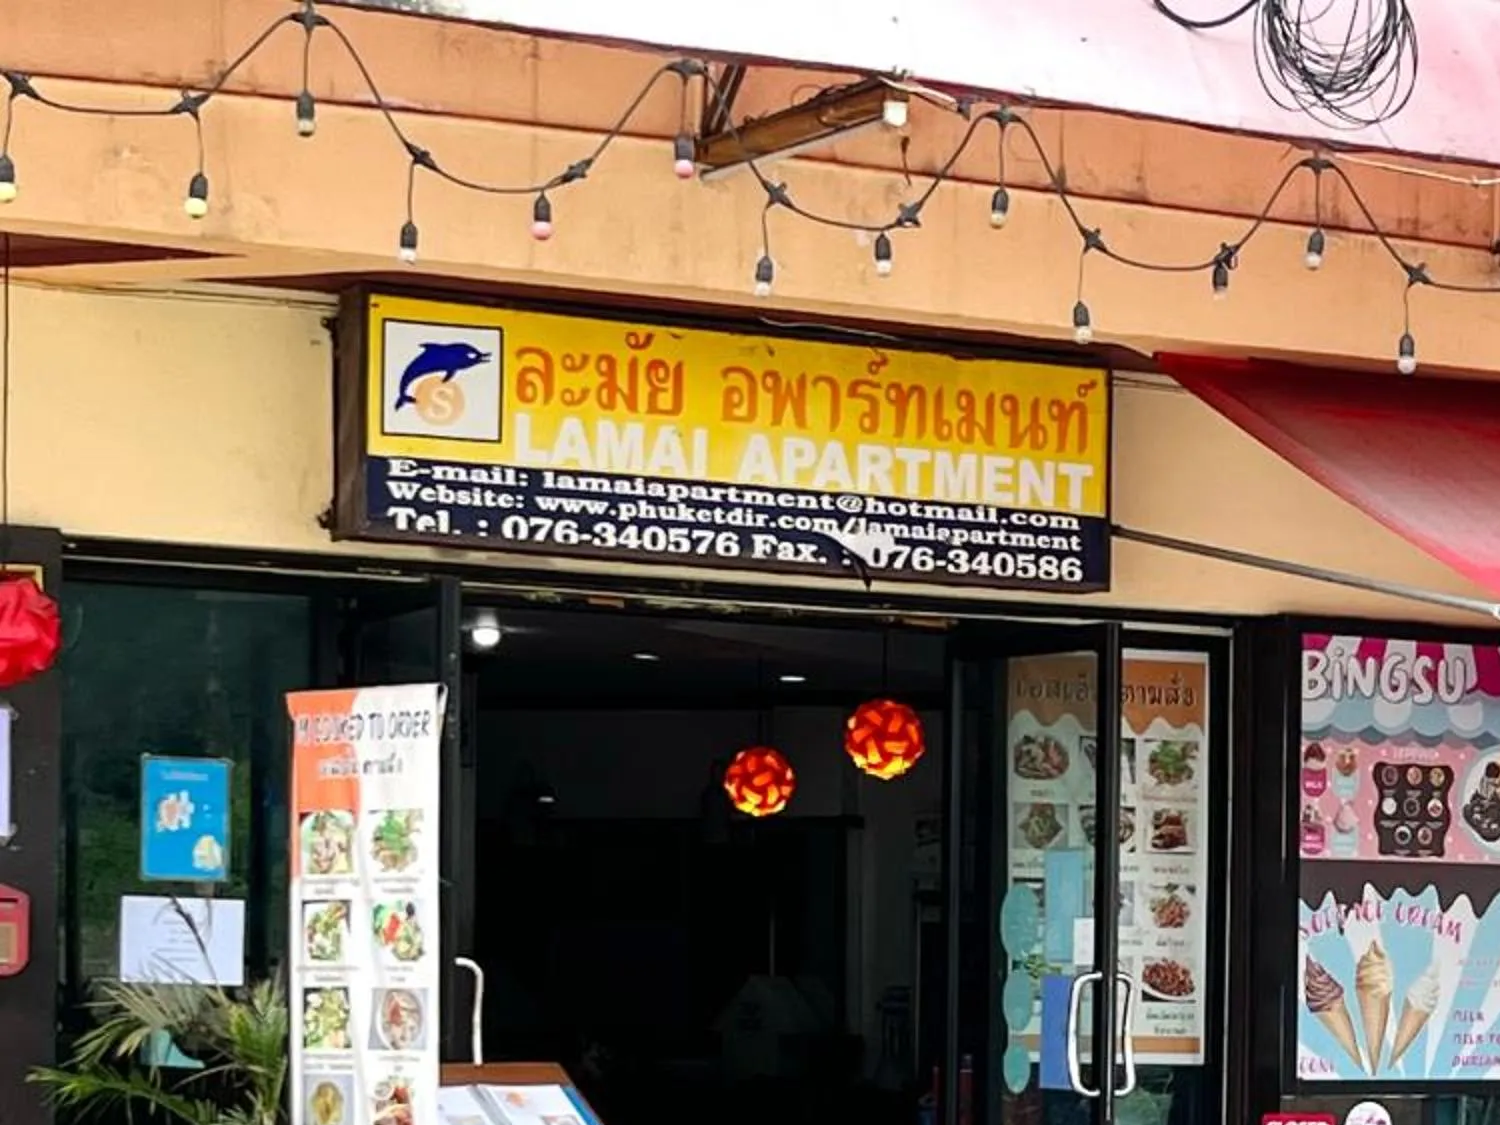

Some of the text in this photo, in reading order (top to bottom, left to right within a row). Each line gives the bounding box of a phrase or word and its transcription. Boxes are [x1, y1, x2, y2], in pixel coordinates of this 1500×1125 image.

[514, 331, 1098, 457] ละมัย อพาร์ทเมนท์
[387, 458, 1081, 531] E-mail: lamaiapartment@hotmail.com
[512, 411, 1095, 513] LAMAI APARTMENT
[386, 480, 1083, 552] Website: www.phuketdir.com/lamaiapartment
[501, 515, 741, 558] 076-340576
[751, 533, 828, 565] Fax.
[868, 546, 1084, 583] 076-340586
